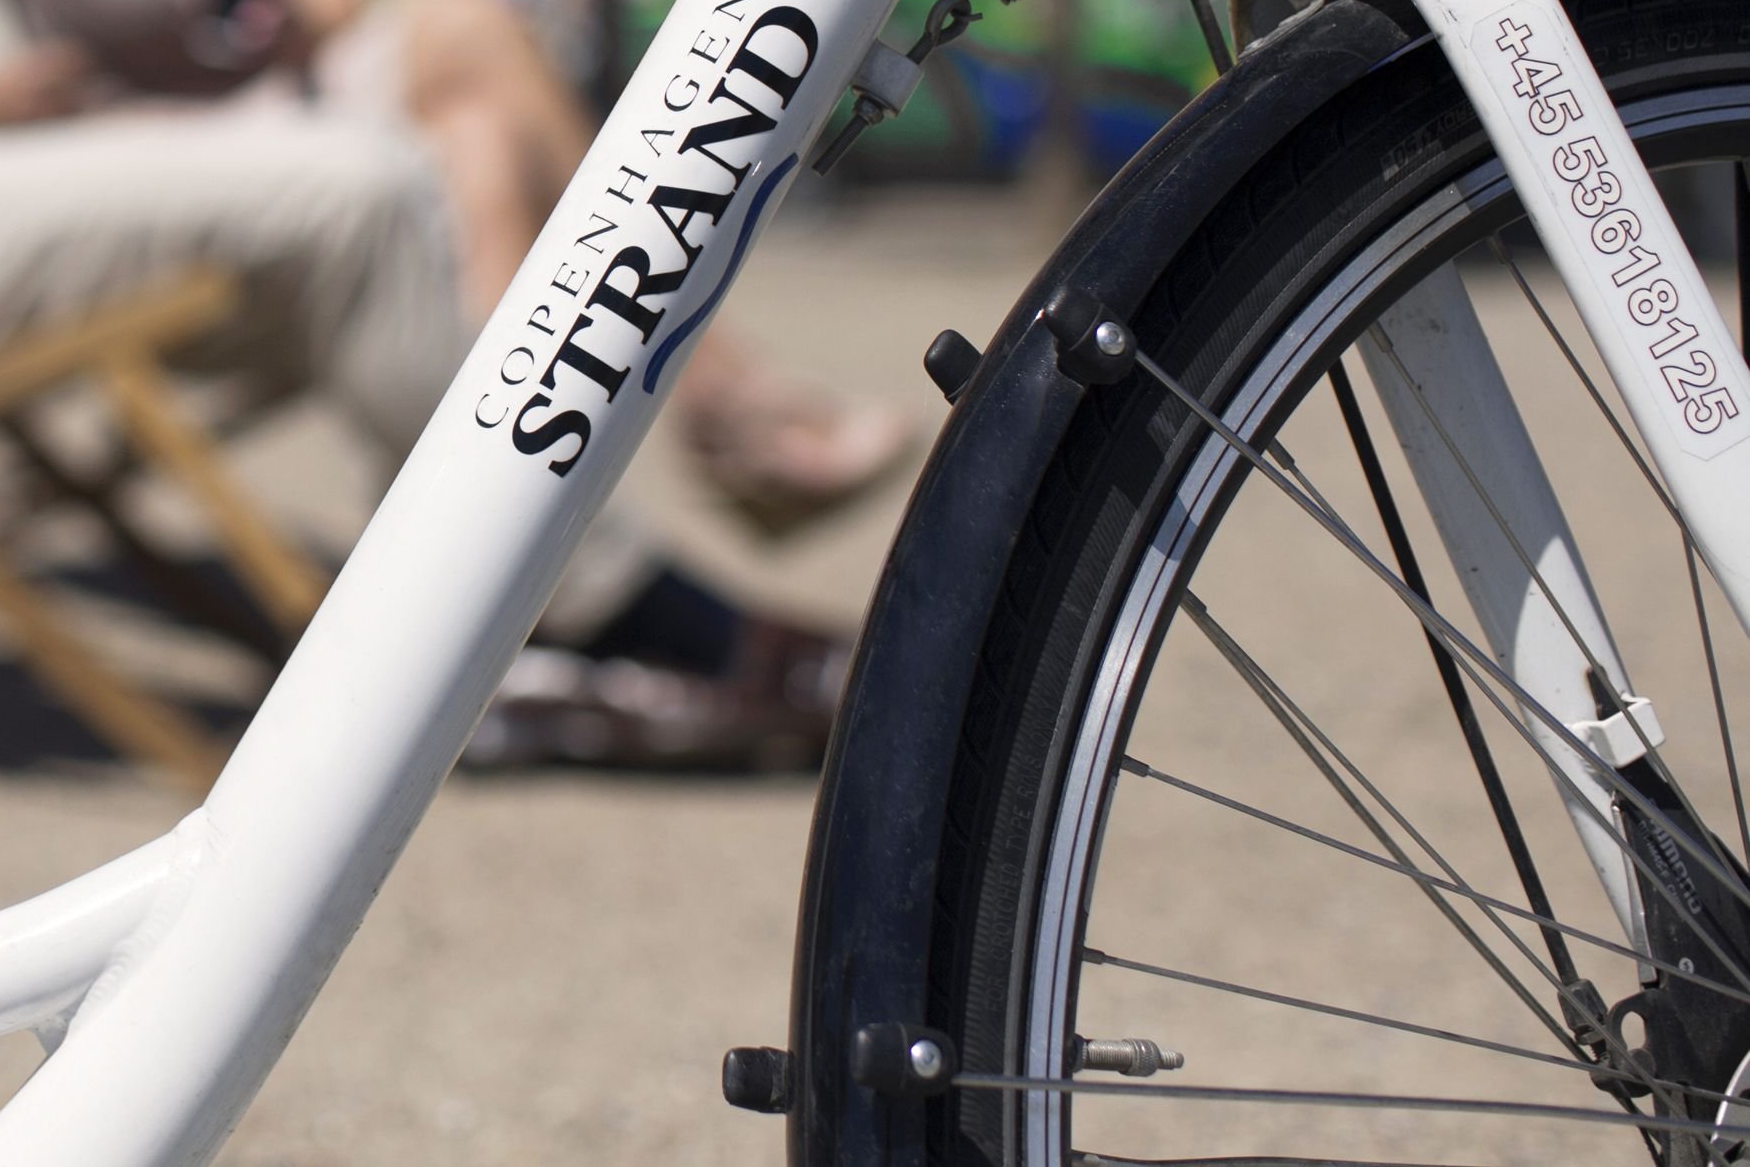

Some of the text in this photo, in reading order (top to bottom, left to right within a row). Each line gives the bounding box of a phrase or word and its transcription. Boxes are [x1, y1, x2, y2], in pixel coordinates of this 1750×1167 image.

[512, 5, 819, 478] STRAND
[1495, 17, 1740, 435] +45 53618125
[1646, 797, 1703, 915] HIMANO
